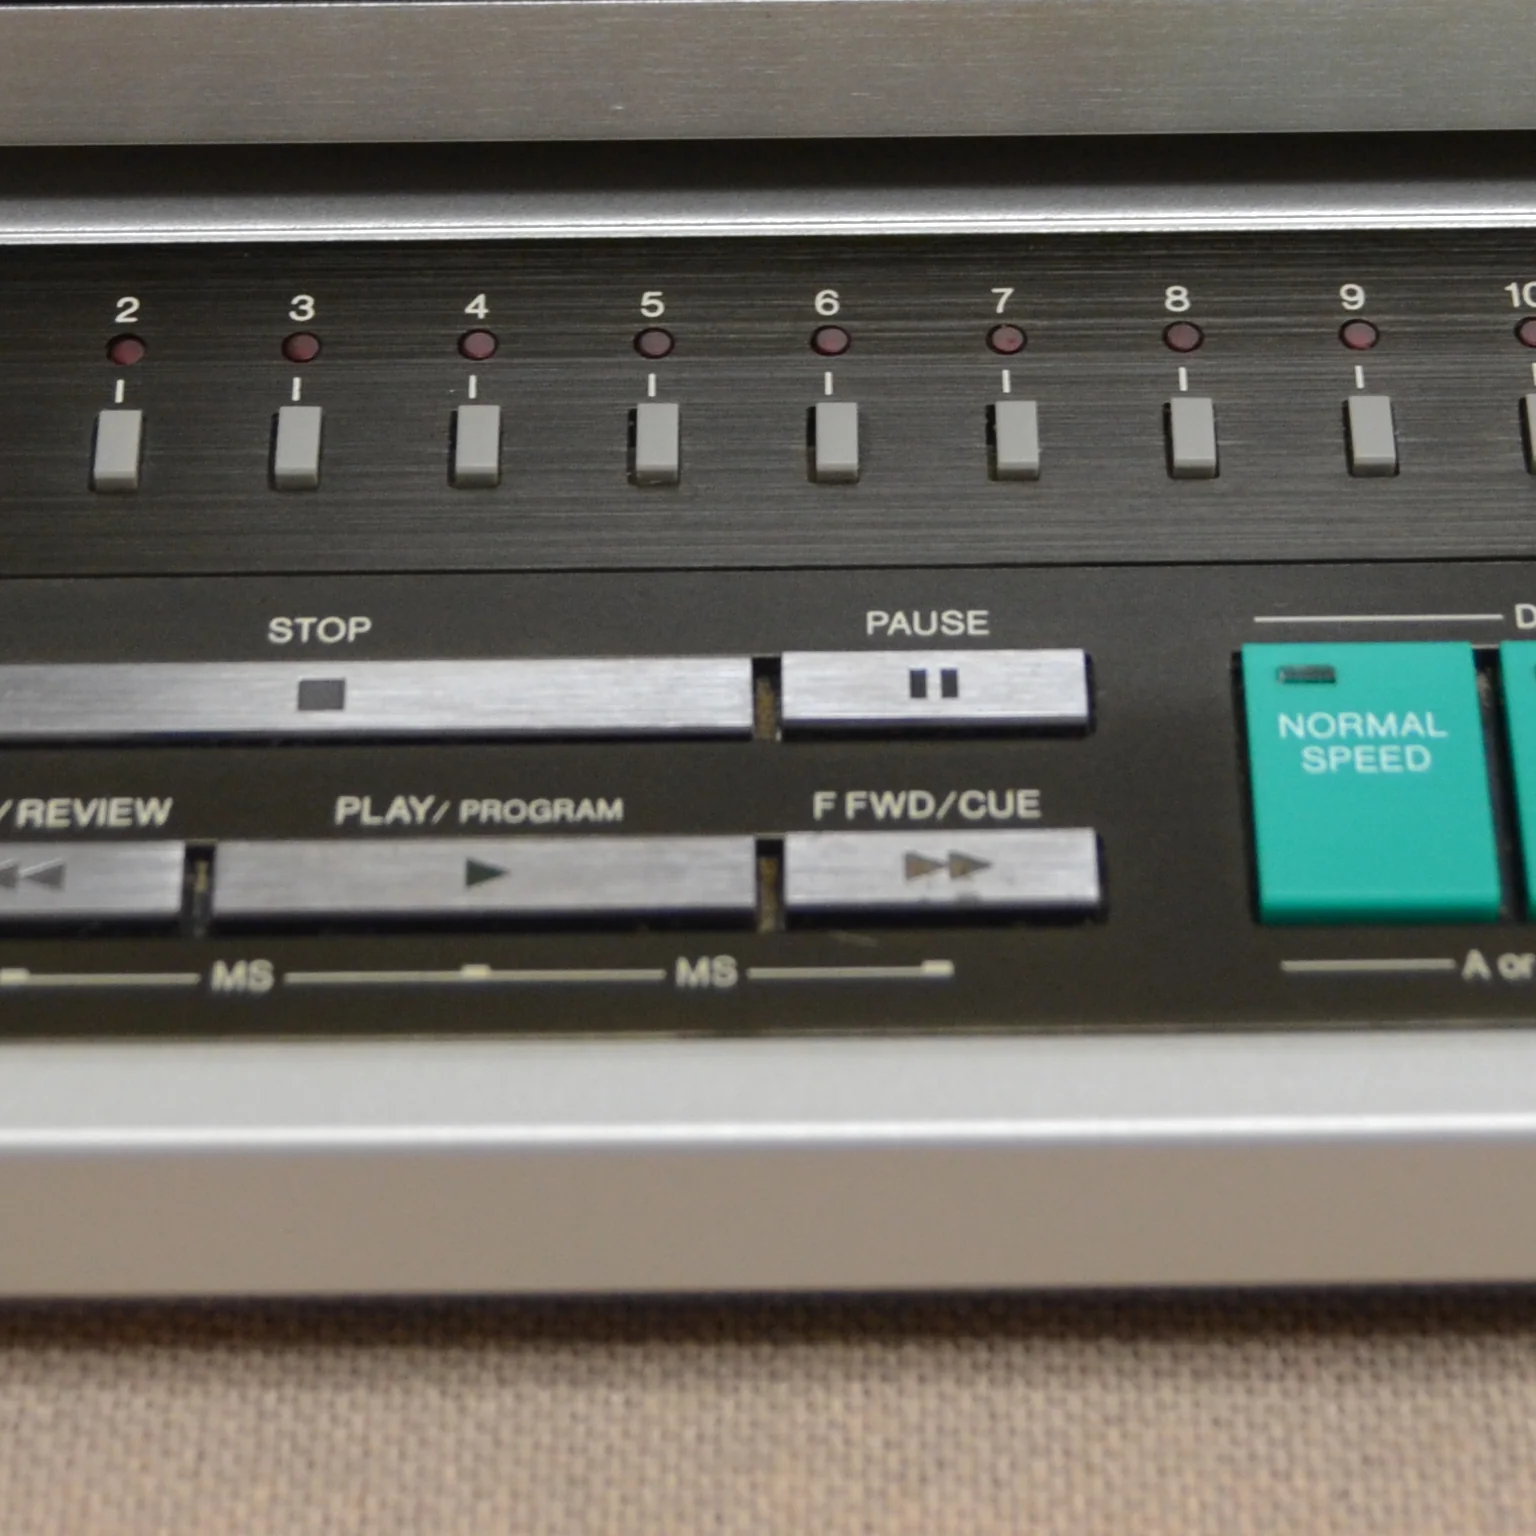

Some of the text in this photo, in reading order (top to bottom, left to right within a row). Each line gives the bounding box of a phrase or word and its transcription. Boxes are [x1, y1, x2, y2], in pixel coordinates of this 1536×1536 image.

[114, 296, 140, 324] 2
[288, 294, 315, 322] 3
[464, 293, 489, 320] 4
[640, 291, 665, 318] 5
[814, 289, 840, 316] 6
[991, 287, 1014, 314] 7
[1164, 285, 1191, 313] 8
[1339, 283, 1366, 311] 9
[268, 616, 372, 644] STOP
[866, 609, 990, 637] PAUSE
[1277, 711, 1447, 740] NORMAL
[1301, 744, 1432, 774] SPEED
[813, 789, 1041, 820] F FWD/CUE
[211, 959, 274, 992] MS
[675, 955, 738, 988] MS
[1462, 949, 1491, 979] A
[1497, 953, 1536, 980] or
